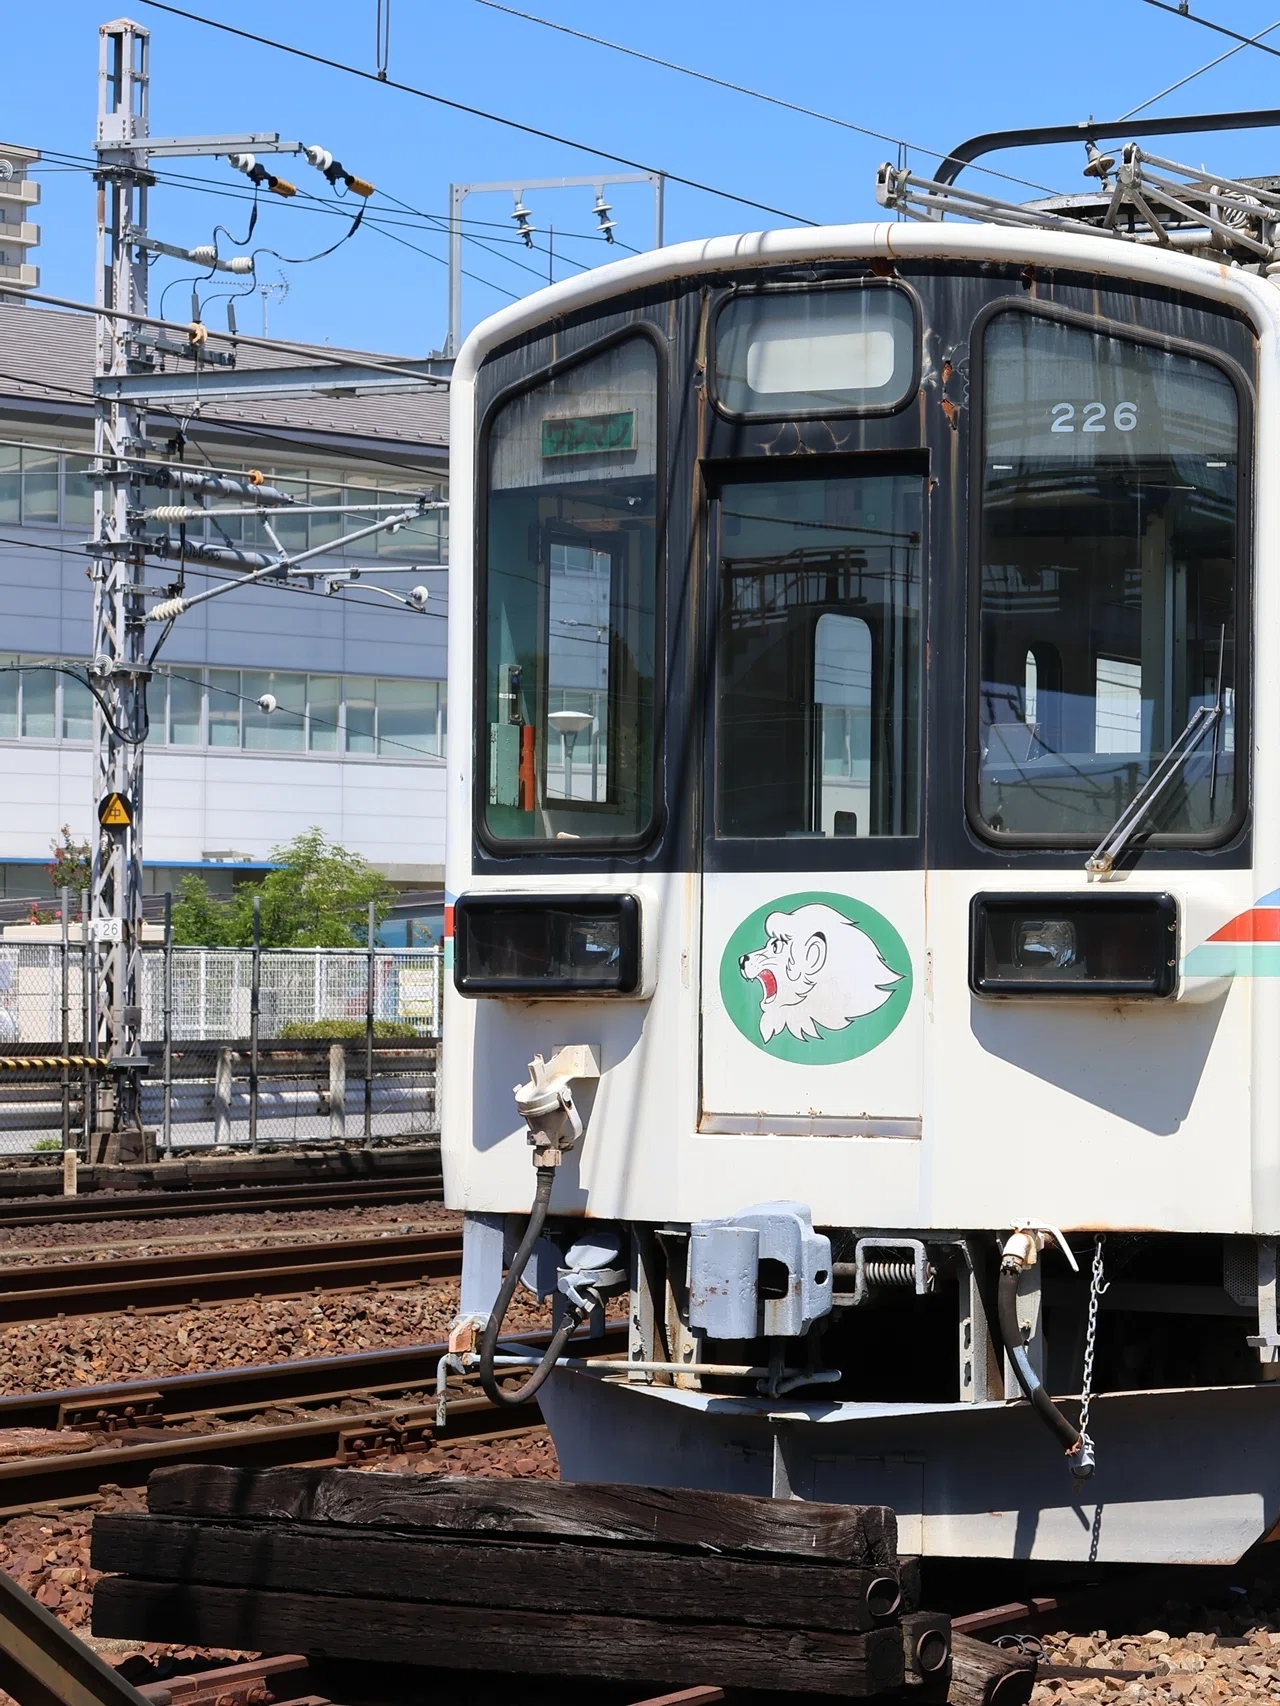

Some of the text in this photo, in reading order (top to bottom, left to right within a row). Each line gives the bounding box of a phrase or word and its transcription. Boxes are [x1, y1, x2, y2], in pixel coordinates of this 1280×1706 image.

[1051, 402, 1137, 432] 226
[547, 415, 630, 452] ワンマン
[103, 923, 119, 936] 26
